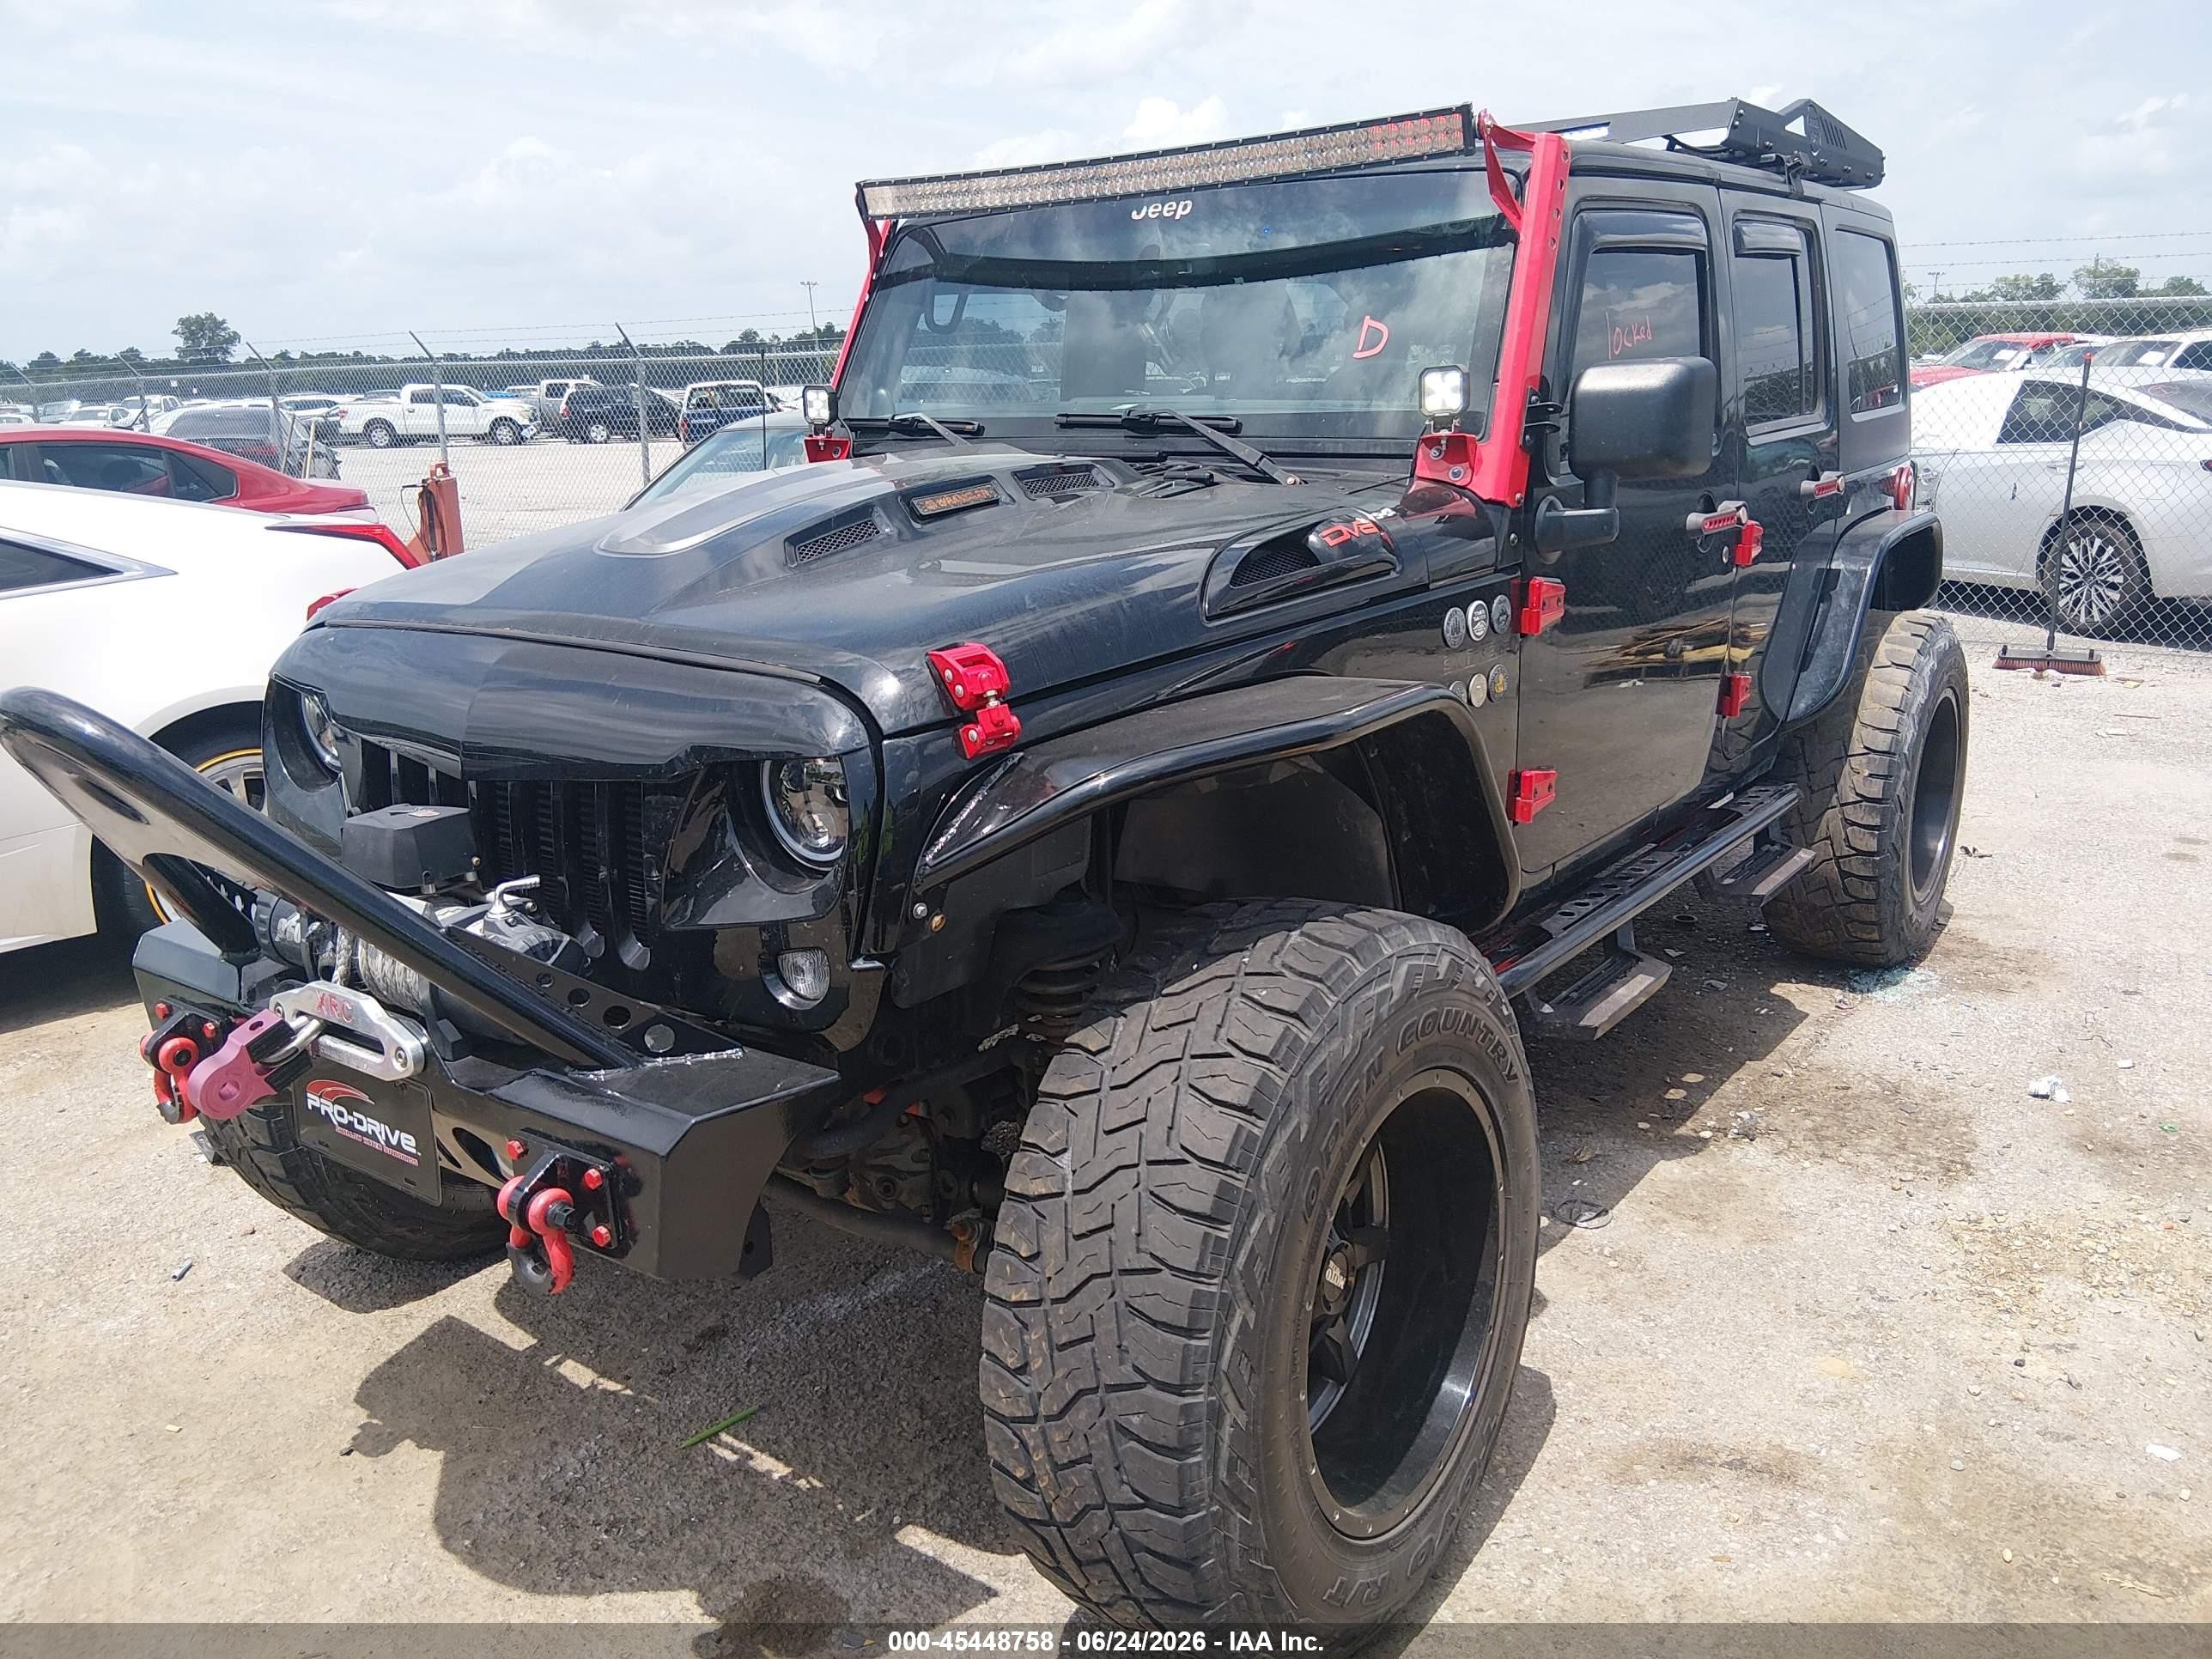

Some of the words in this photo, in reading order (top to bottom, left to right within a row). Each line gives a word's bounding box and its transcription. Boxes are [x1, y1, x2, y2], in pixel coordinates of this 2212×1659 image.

[1131, 200, 1193, 220] Jeep
[1353, 315, 1388, 358] D
[315, 988, 353, 1023] XRC
[1304, 1045, 1385, 1224] OPEN
[1396, 1006, 1519, 1085] COUNTRY
[1322, 1571, 1389, 1607] R/T
